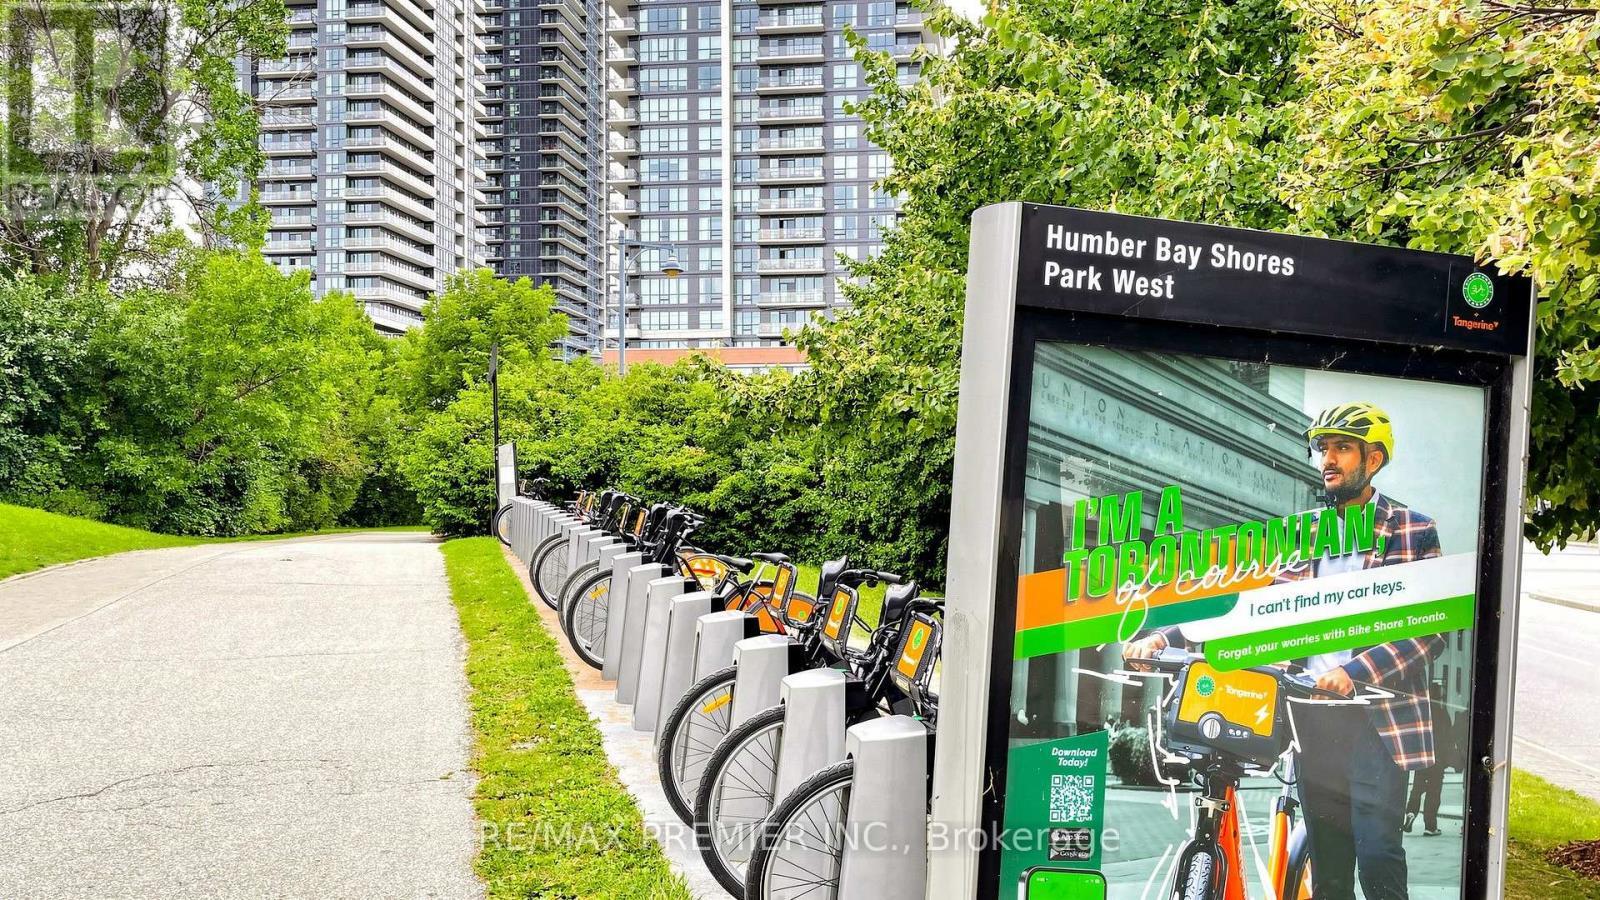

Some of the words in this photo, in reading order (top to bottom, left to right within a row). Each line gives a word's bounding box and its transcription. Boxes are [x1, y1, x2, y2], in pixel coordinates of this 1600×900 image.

[1046, 224, 1147, 259] Humber
[1156, 236, 1202, 270] Bay
[1210, 243, 1295, 276] Shores
[1044, 261, 1102, 292] Park
[1113, 268, 1175, 299] West
[1453, 316, 1496, 330] Tangerine
[1042, 372, 1125, 420] UNION
[1154, 421, 1243, 470] STATION
[1071, 490, 1143, 551] I'M
[1154, 485, 1185, 537] A
[1063, 502, 1387, 602] TORONTONIAN,
[1115, 558, 1163, 644] of
[1175, 549, 1309, 595] course
[1257, 598, 1291, 616] can't
[1294, 592, 1320, 612] find
[1324, 590, 1344, 606] my
[1347, 586, 1369, 599] car
[1373, 580, 1405, 597] keys.
[1217, 645, 1252, 660] Forget
[1255, 642, 1279, 656] your
[1281, 633, 1320, 648] worries
[1322, 628, 1345, 641] with
[1348, 624, 1371, 636] Bike
[1373, 619, 1403, 632] Share
[1051, 747, 1098, 757] Download
[1058, 757, 1089, 769] Today!
